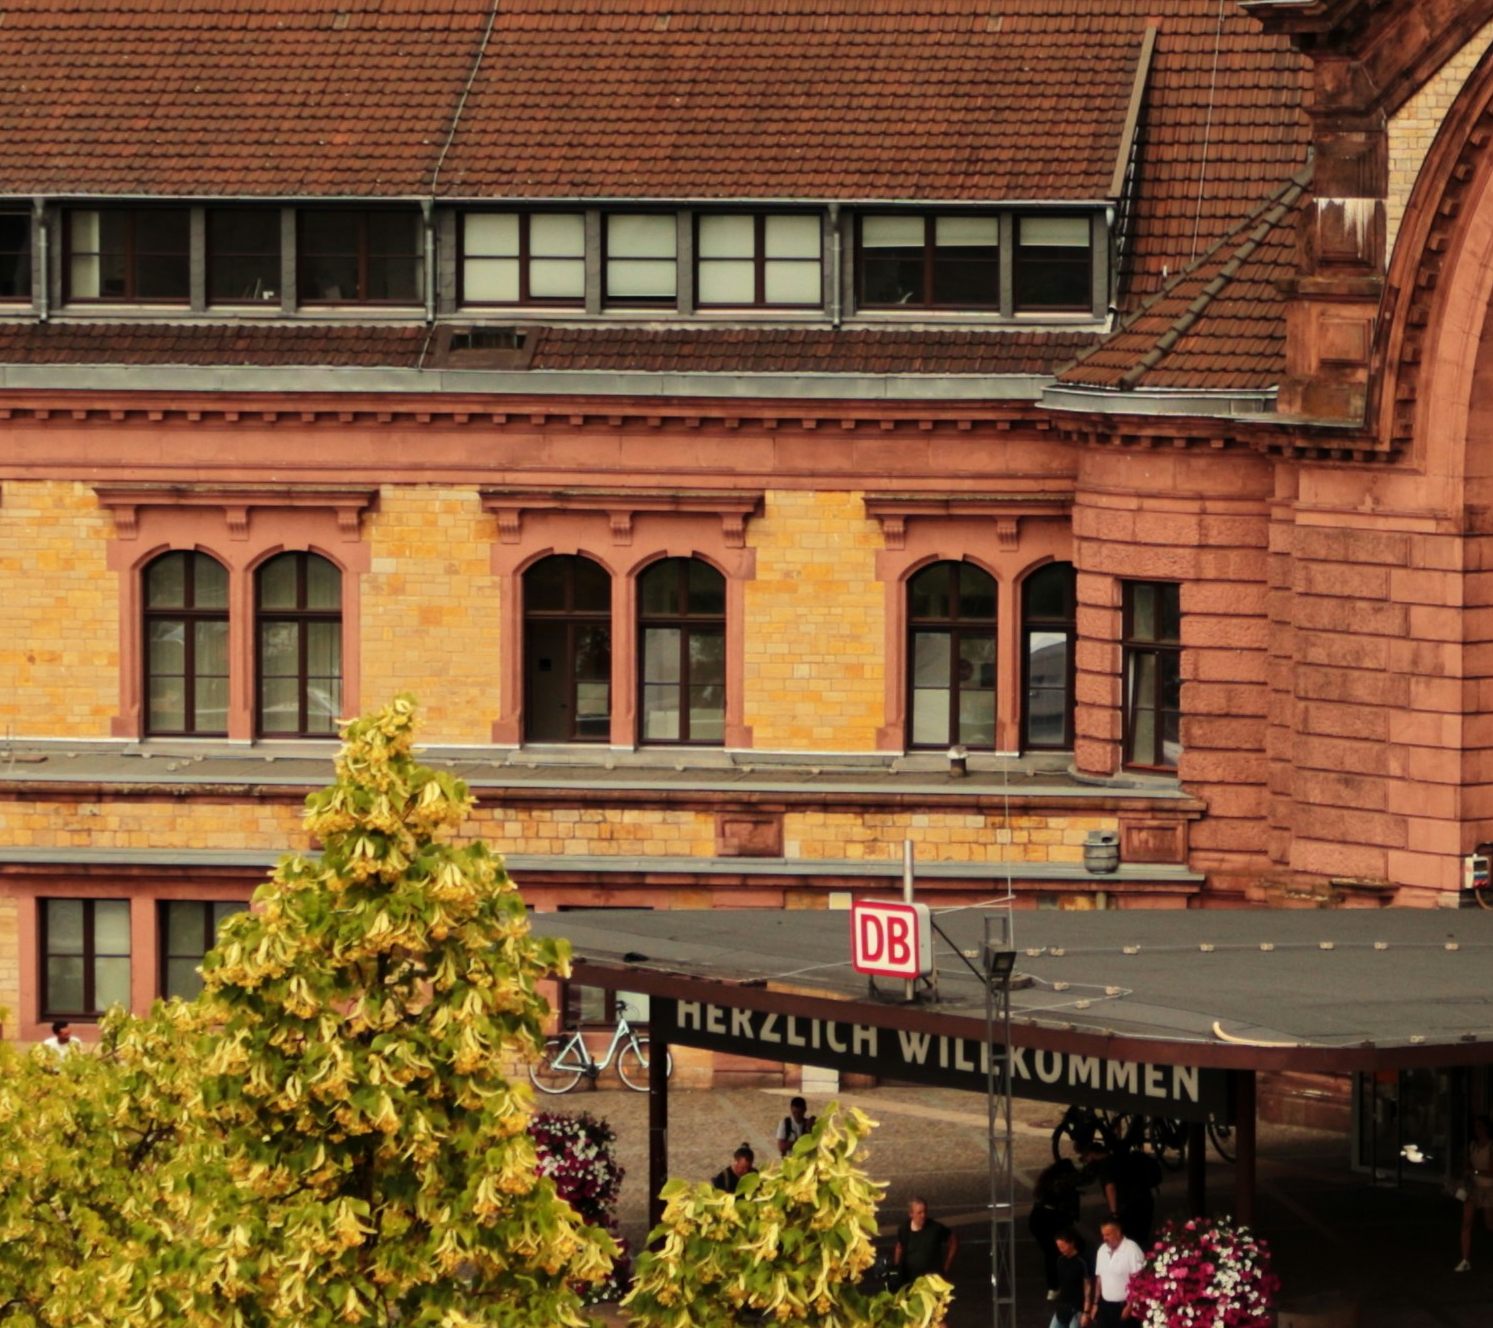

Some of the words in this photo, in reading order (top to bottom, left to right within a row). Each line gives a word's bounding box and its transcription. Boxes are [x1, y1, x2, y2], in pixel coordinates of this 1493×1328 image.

[860, 913, 911, 965] DB
[676, 999, 878, 1058] HERZLICH
[897, 1029, 1199, 1103] WILLKOMMEN
